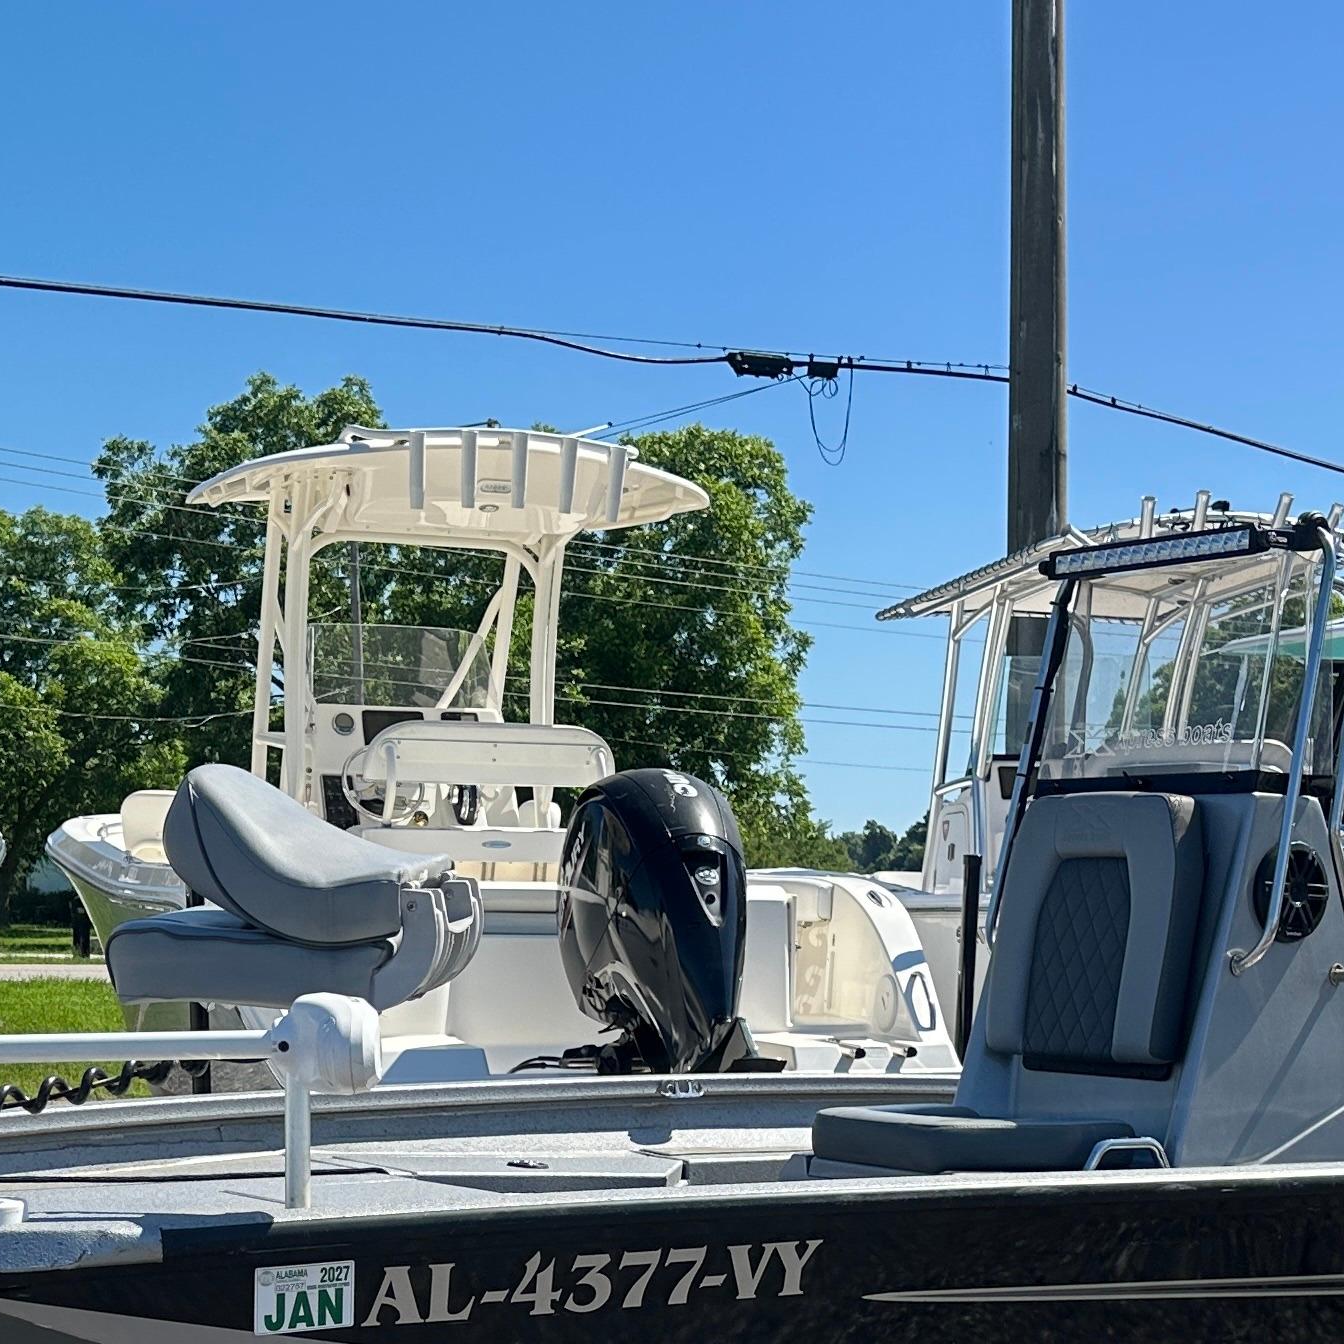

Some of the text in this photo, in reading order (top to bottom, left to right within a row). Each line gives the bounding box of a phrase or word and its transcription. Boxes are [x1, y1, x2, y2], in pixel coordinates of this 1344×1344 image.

[275, 1265, 351, 1283] ALABAMA 2027
[360, 1238, 824, 1329] AL-4377-VY
[263, 1287, 344, 1332] JAN
